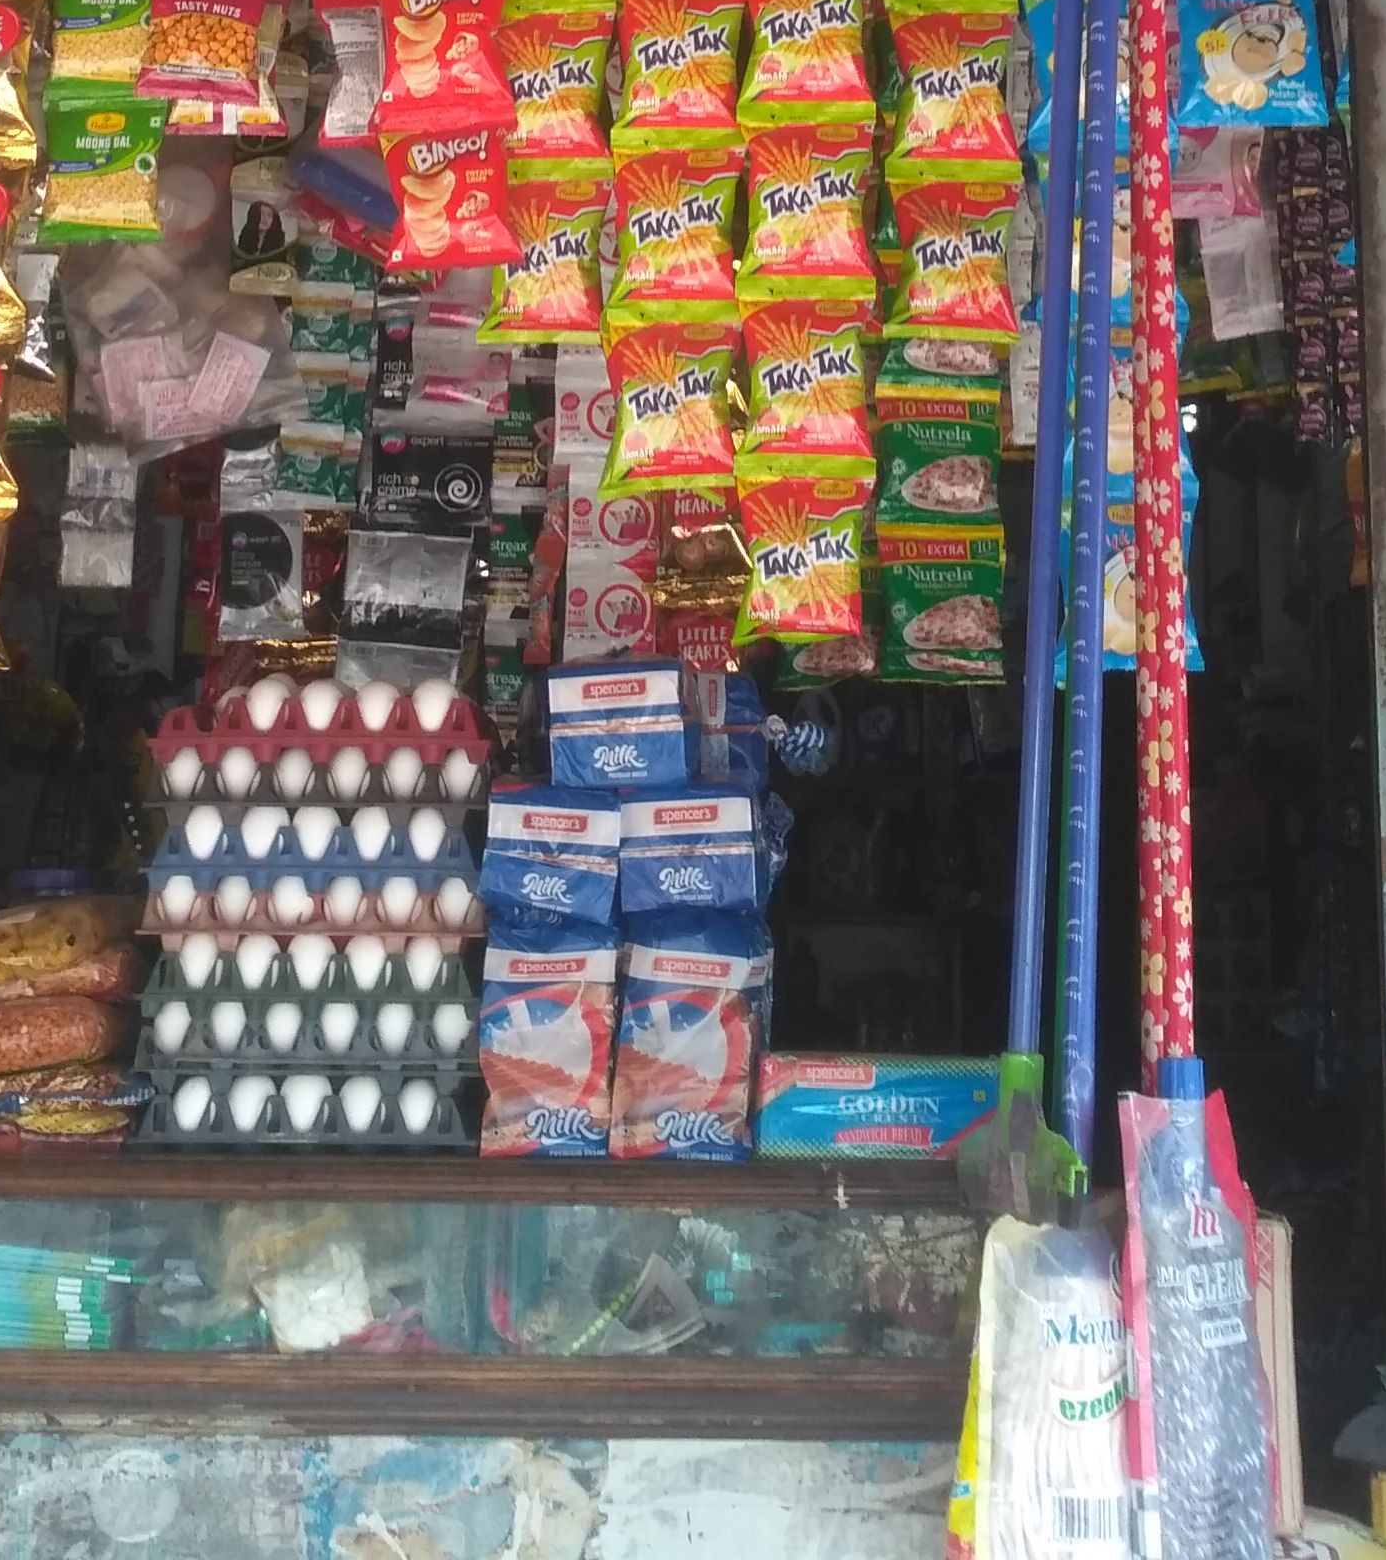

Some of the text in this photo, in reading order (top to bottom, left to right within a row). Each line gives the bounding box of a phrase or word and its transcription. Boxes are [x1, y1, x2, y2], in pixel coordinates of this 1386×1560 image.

[174, 1, 242, 18] TASTY NUTS
[638, 25, 730, 73] TAKA-TAK
[916, 56, 1002, 101] TAKA-TAK
[76, 135, 132, 149] MOONG DAL
[413, 130, 488, 172] BINGO!
[764, 172, 856, 215] TAKA-TAK
[633, 195, 723, 244] TAKA-TAK
[916, 228, 1003, 270] TAKA-TAK
[762, 345, 856, 395] TAKA-TAK
[629, 369, 716, 419] TAKA-TAK
[926, 402, 964, 416] EXTRA
[907, 423, 973, 442] Nutrela
[377, 473, 402, 485] rich
[489, 539, 528, 553] streax
[756, 529, 852, 580] TAKA-TAK
[927, 543, 965, 556] EXTRA
[907, 564, 973, 582] Nutrela
[589, 681, 641, 700] spencer's
[593, 744, 648, 772] Milk
[530, 815, 582, 832] spencer's
[661, 806, 713, 824] spencer's
[521, 872, 574, 904] Milk
[659, 866, 712, 894] Milk
[516, 959, 580, 975] spencer's
[659, 959, 723, 977] spencer's
[805, 1064, 866, 1083] spencer's
[838, 1093, 941, 1116] GOLDEN
[526, 1107, 606, 1146] Milk
[654, 1109, 735, 1147] Milk
